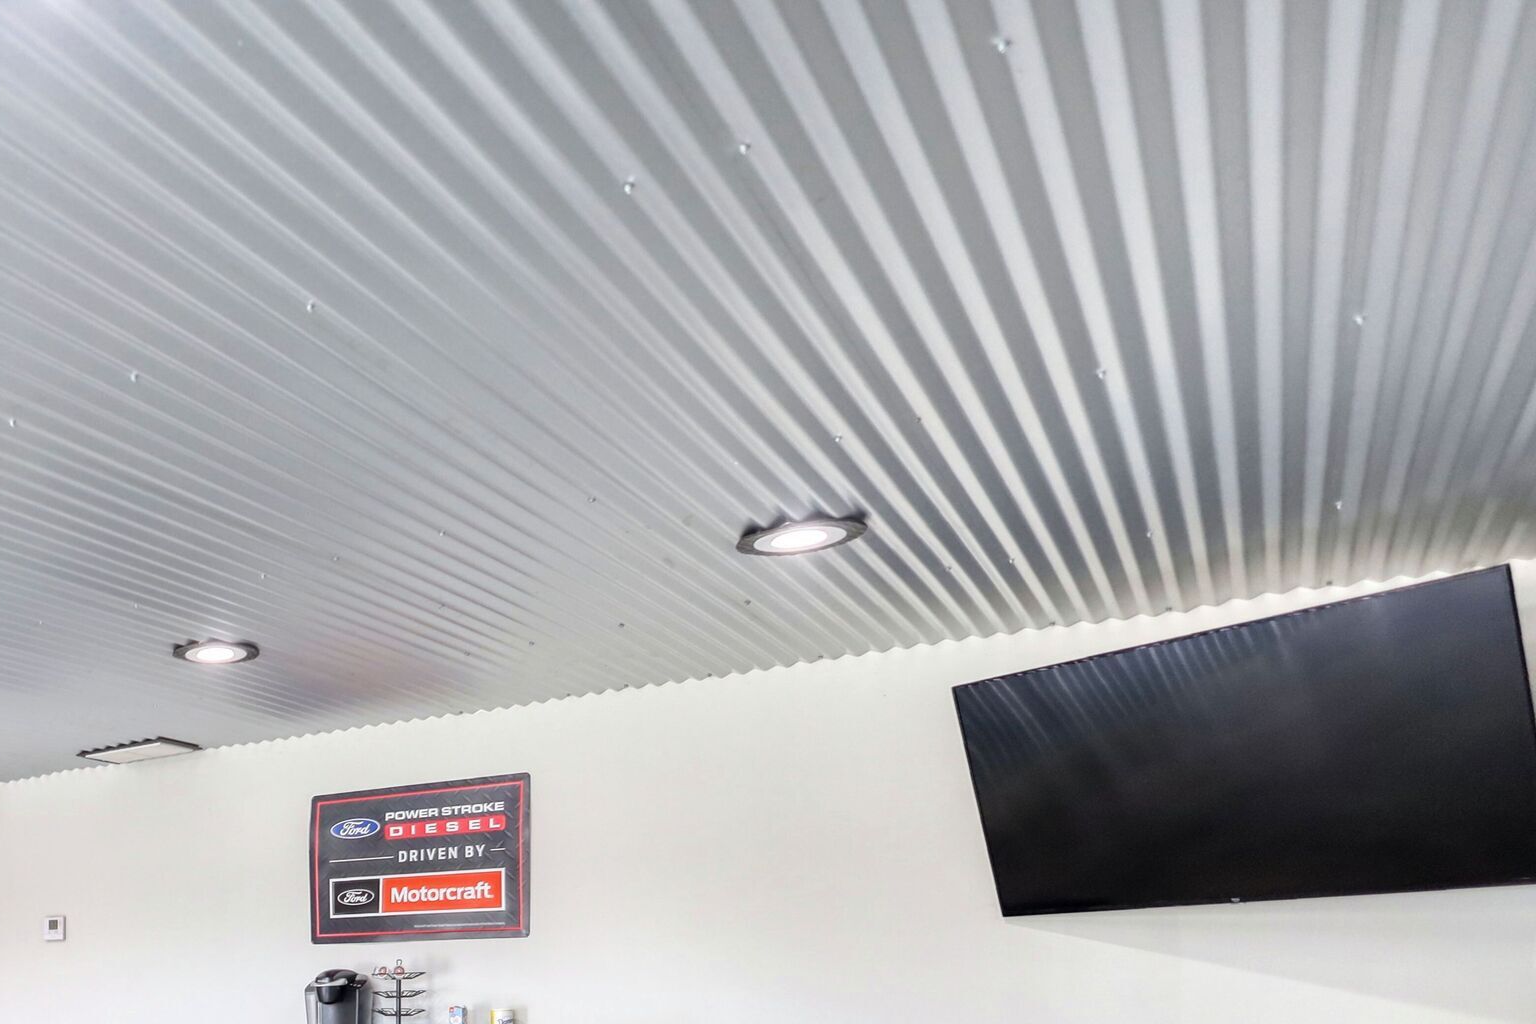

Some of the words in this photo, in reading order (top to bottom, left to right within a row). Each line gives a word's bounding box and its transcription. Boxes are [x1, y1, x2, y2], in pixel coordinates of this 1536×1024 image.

[385, 807, 439, 822] POWER
[441, 801, 505, 816] STROKE
[389, 818, 501, 837] DIESEL
[398, 846, 459, 863] DRIVEN
[464, 843, 486, 858] BY
[390, 881, 492, 904] Motorcraft
